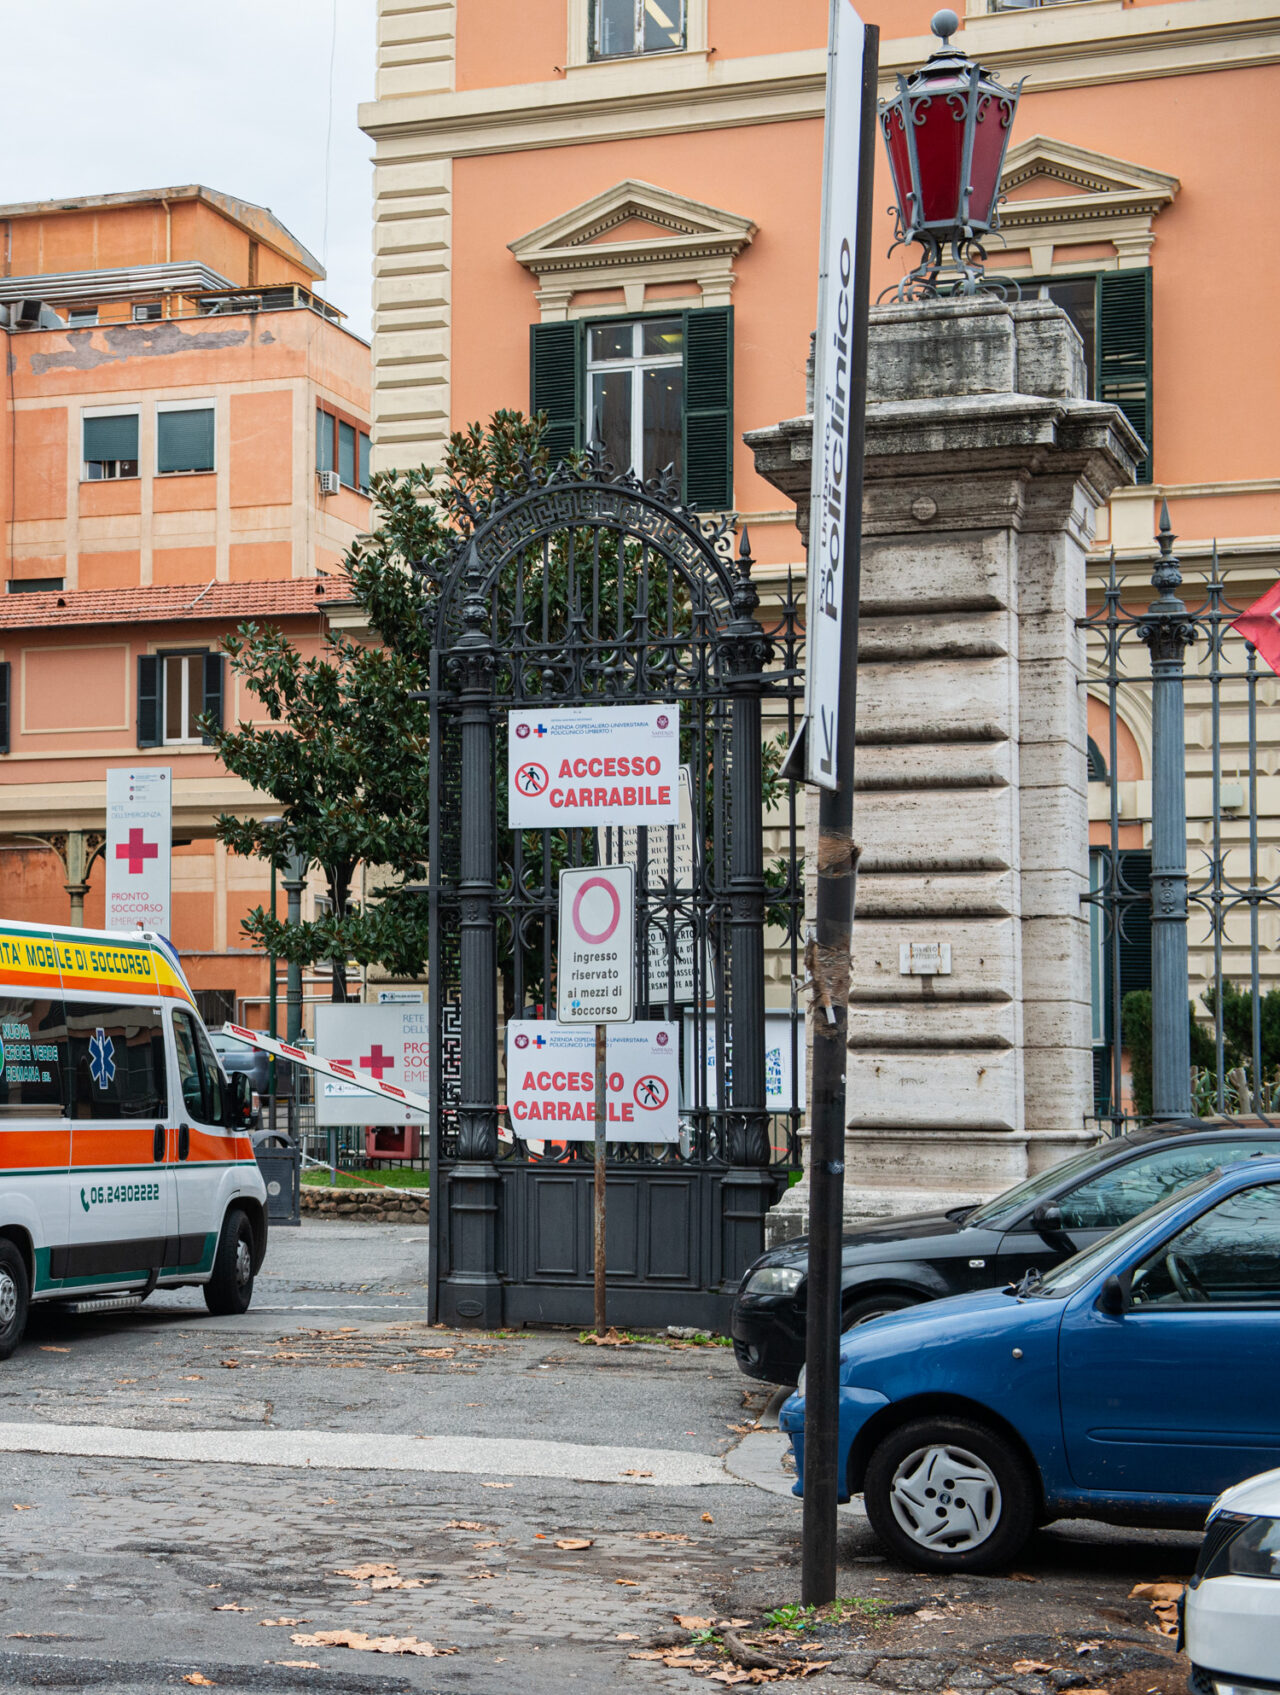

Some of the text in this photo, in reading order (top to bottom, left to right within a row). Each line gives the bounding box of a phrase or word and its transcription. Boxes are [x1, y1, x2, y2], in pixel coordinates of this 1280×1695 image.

[825, 237, 851, 621] Policlinico
[558, 756, 661, 778] ACCESSO
[549, 785, 671, 808] CARRABILE
[111, 892, 149, 901] PRONTO
[111, 903, 164, 913] SOCCORSO
[25, 944, 74, 970] MOBILE
[75, 949, 88, 971] DI
[90, 951, 151, 976] SOCCORSO
[573, 952, 618, 965] ingresso
[571, 968, 619, 981] riservato
[567, 986, 622, 999] ai mezzi di
[571, 1005, 618, 1016] soccorso
[403, 1014, 424, 1022] RETE
[2, 1023, 31, 1039] NUOVA
[5, 1044, 58, 1061] CROCE VERDE
[403, 1042, 430, 1054] PRO
[403, 1056, 430, 1068] SOC
[6, 1066, 40, 1082] ROMANA
[404, 1070, 429, 1082] EME
[522, 1071, 625, 1092] ACCESO
[513, 1100, 635, 1122] CARRABLE
[90, 1183, 160, 1204] 06.24302222
